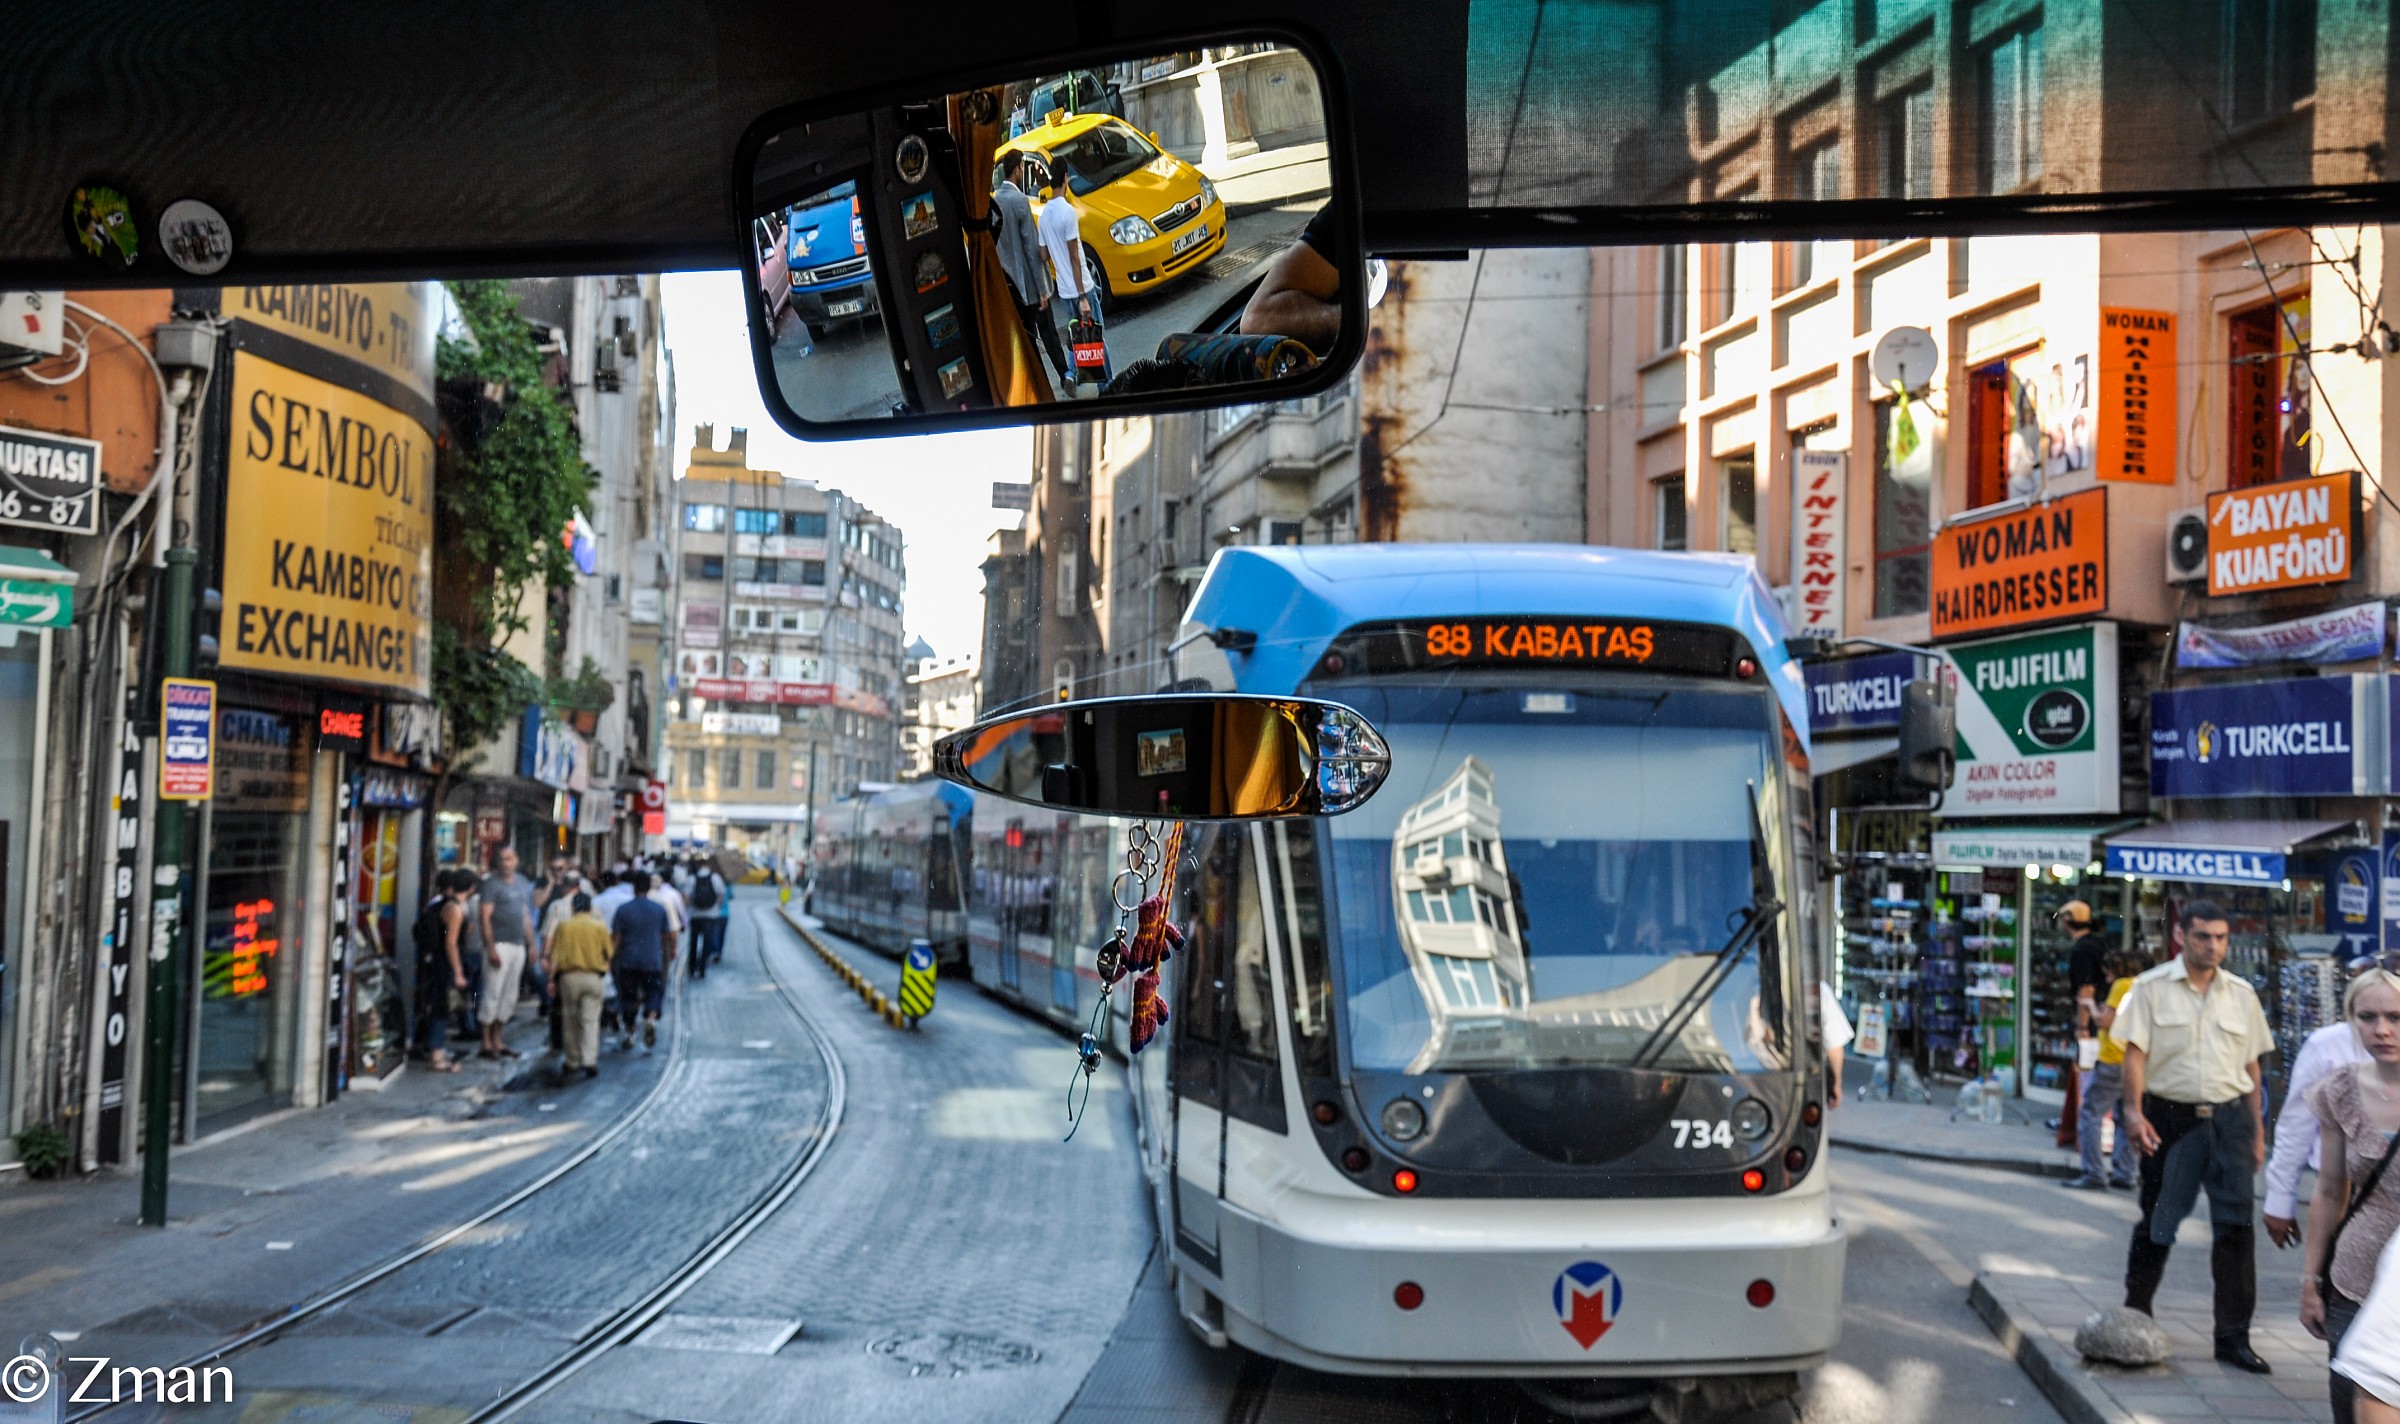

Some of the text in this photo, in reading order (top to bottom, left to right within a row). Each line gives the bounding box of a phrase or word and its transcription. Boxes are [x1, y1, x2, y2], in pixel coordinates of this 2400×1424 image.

[2105, 311, 2170, 333] WOMAN
[2122, 335, 2150, 476] HAIRDRESSER
[245, 389, 413, 506] SEMBOL
[49, 494, 85, 527] 87
[2230, 485, 2330, 538] BAYAN
[1957, 508, 2073, 570] WOMAN
[2215, 528, 2346, 590] KUAFÖRÜ
[272, 540, 402, 611] KAMBİYO
[1935, 562, 2098, 625] HAIRDRESSER
[236, 603, 404, 674] EXCHANGE
[1426, 624, 1654, 664] 38 KABATAŞ
[1975, 648, 2087, 692] FUJIFILM
[2224, 720, 2350, 758] TURKCELL
[2002, 760, 2056, 782] COLOR
[2119, 849, 2271, 880] TURKCELL
[1670, 1120, 1734, 1150] 734
